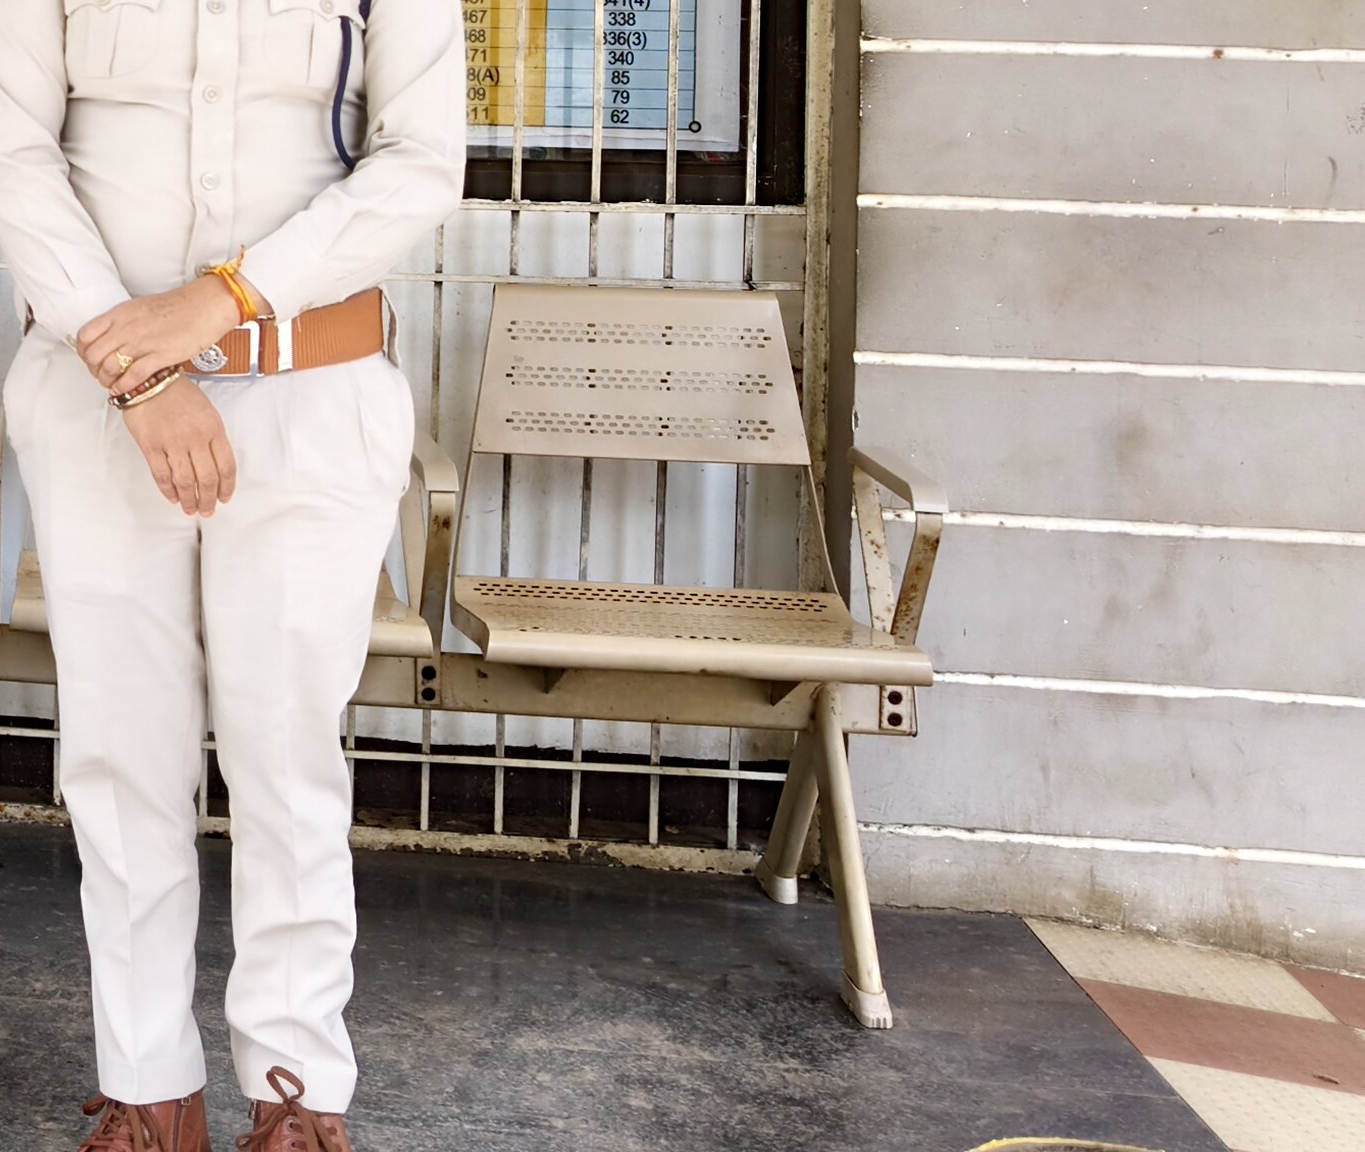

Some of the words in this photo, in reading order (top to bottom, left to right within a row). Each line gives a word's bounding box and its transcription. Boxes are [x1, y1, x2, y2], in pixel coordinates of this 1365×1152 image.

[608, 12, 636, 26] 338
[464, 29, 486, 43] 68
[465, 49, 487, 63] 71
[608, 51, 635, 65] 340
[611, 71, 630, 85] 85
[611, 90, 630, 104] 79
[610, 110, 629, 124] 62
